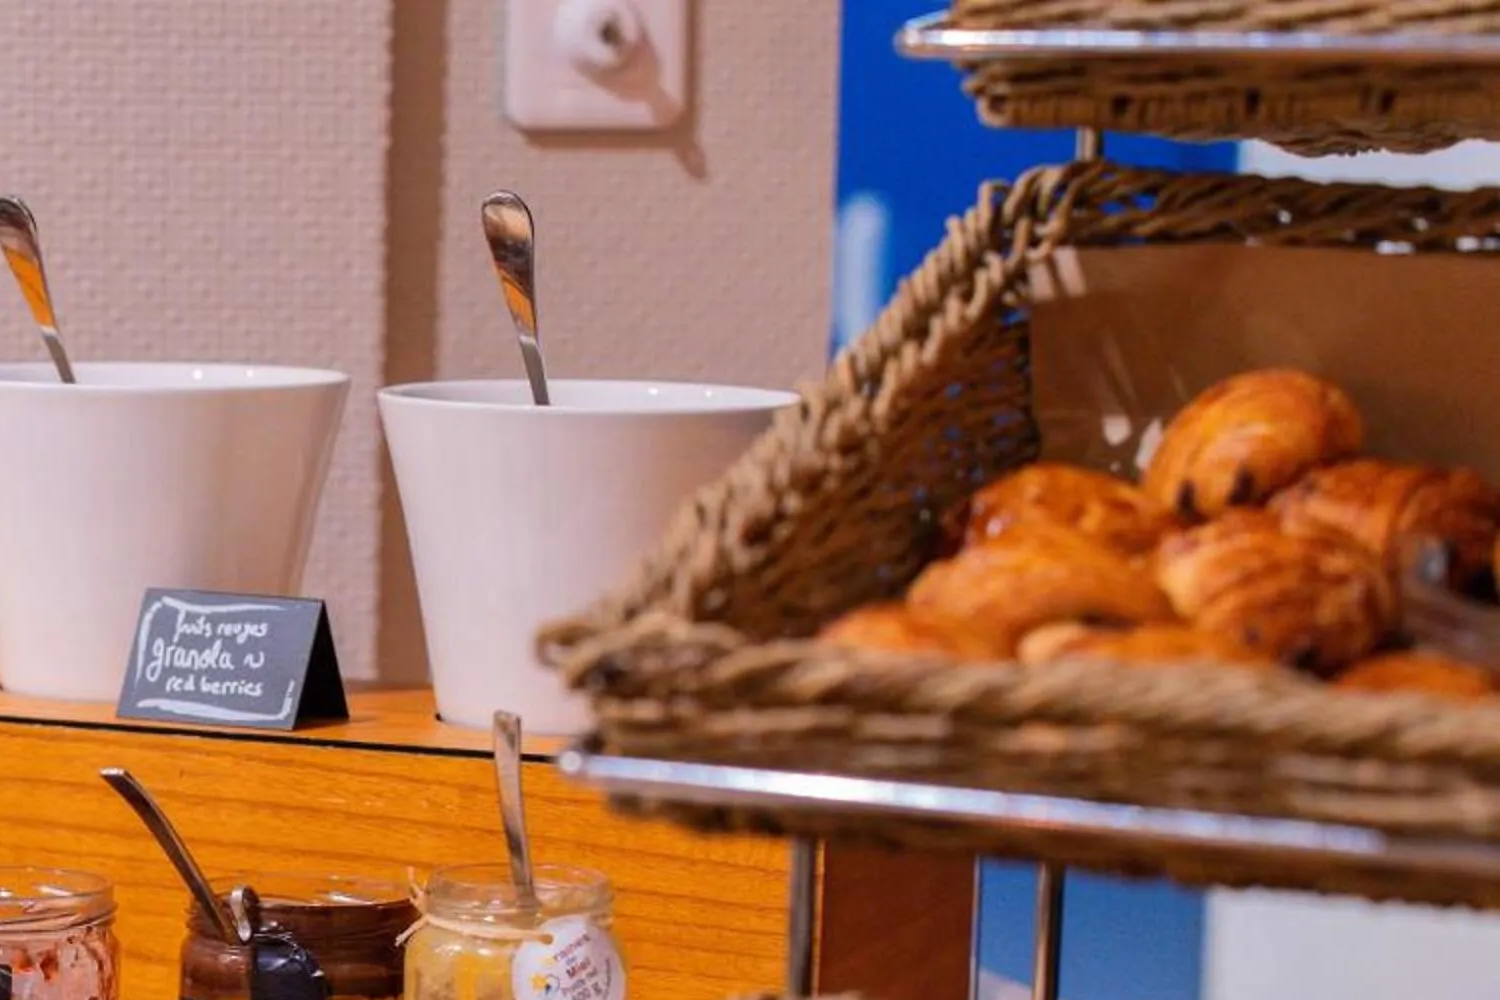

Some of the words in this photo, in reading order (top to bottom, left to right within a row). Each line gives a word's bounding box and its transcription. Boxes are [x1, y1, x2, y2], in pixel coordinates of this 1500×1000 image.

[217, 622, 269, 644] rouges
[145, 637, 235, 682] granola
[165, 674, 196, 693] red
[200, 676, 264, 696] berries
